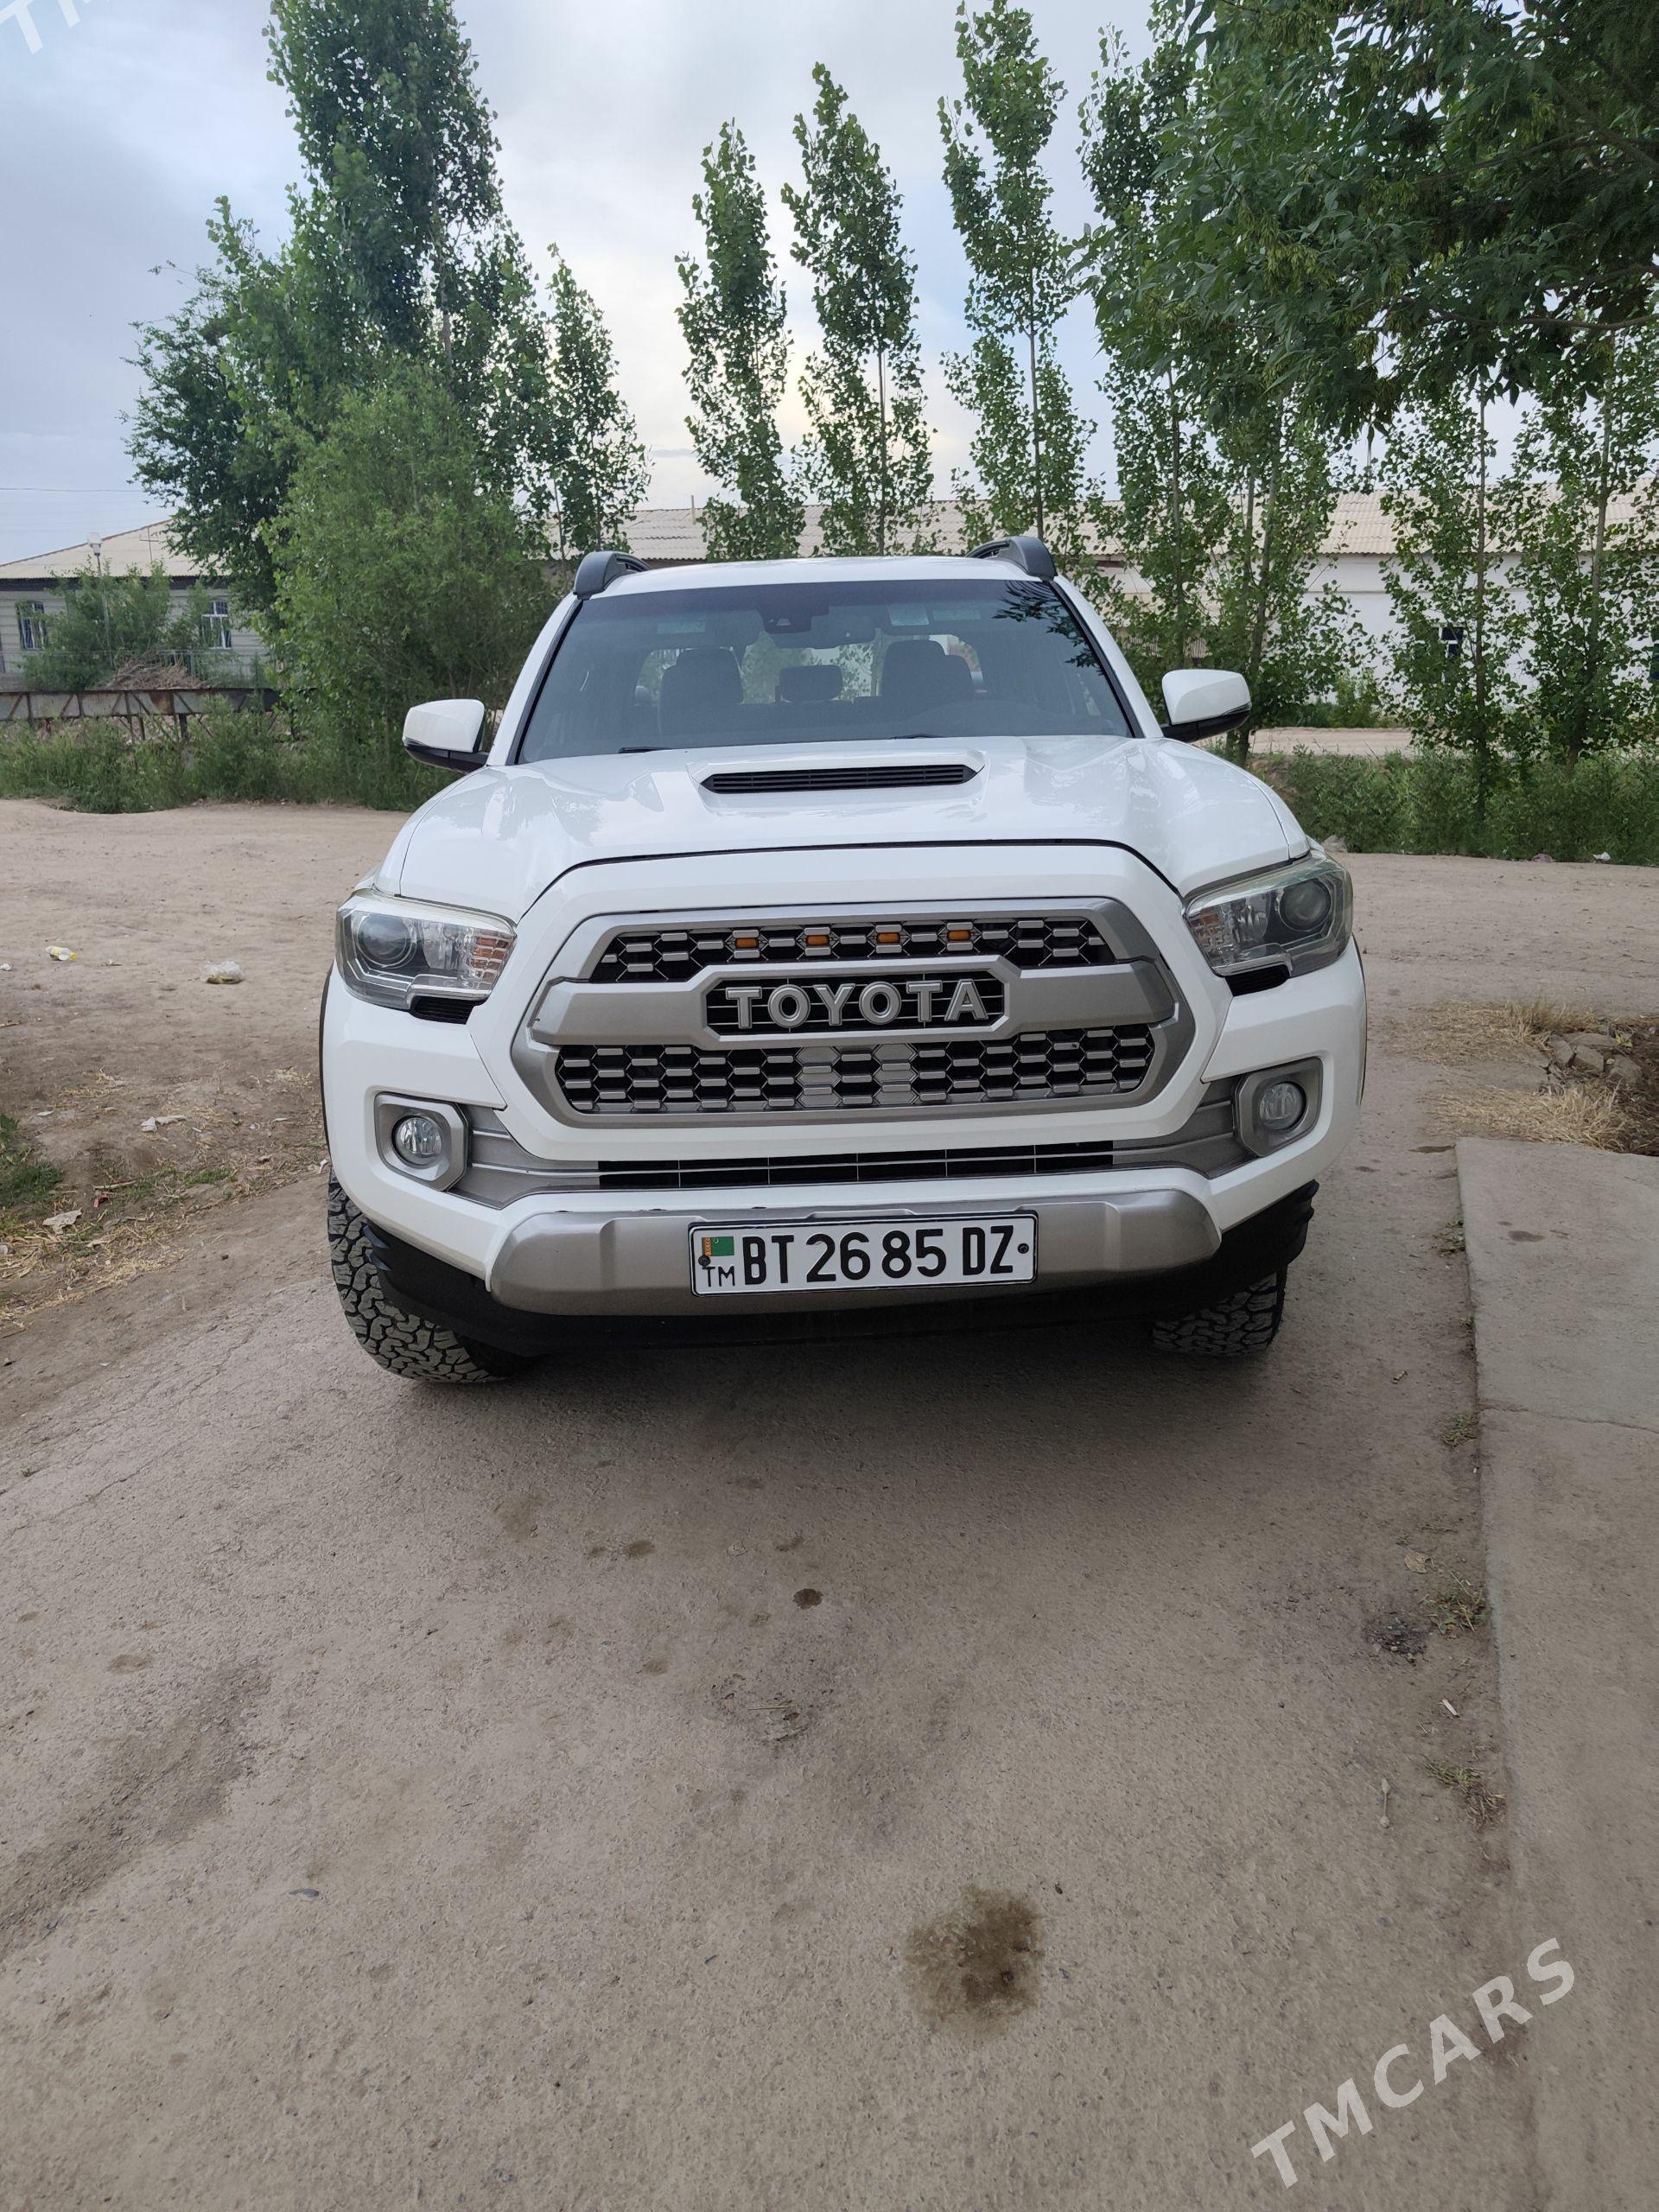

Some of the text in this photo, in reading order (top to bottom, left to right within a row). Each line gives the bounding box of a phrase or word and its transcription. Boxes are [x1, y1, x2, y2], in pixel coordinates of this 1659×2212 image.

[725, 978, 988, 1029] TOYOTA
[702, 1265, 735, 1287] TM
[962, 1225, 1014, 1276] DZ
